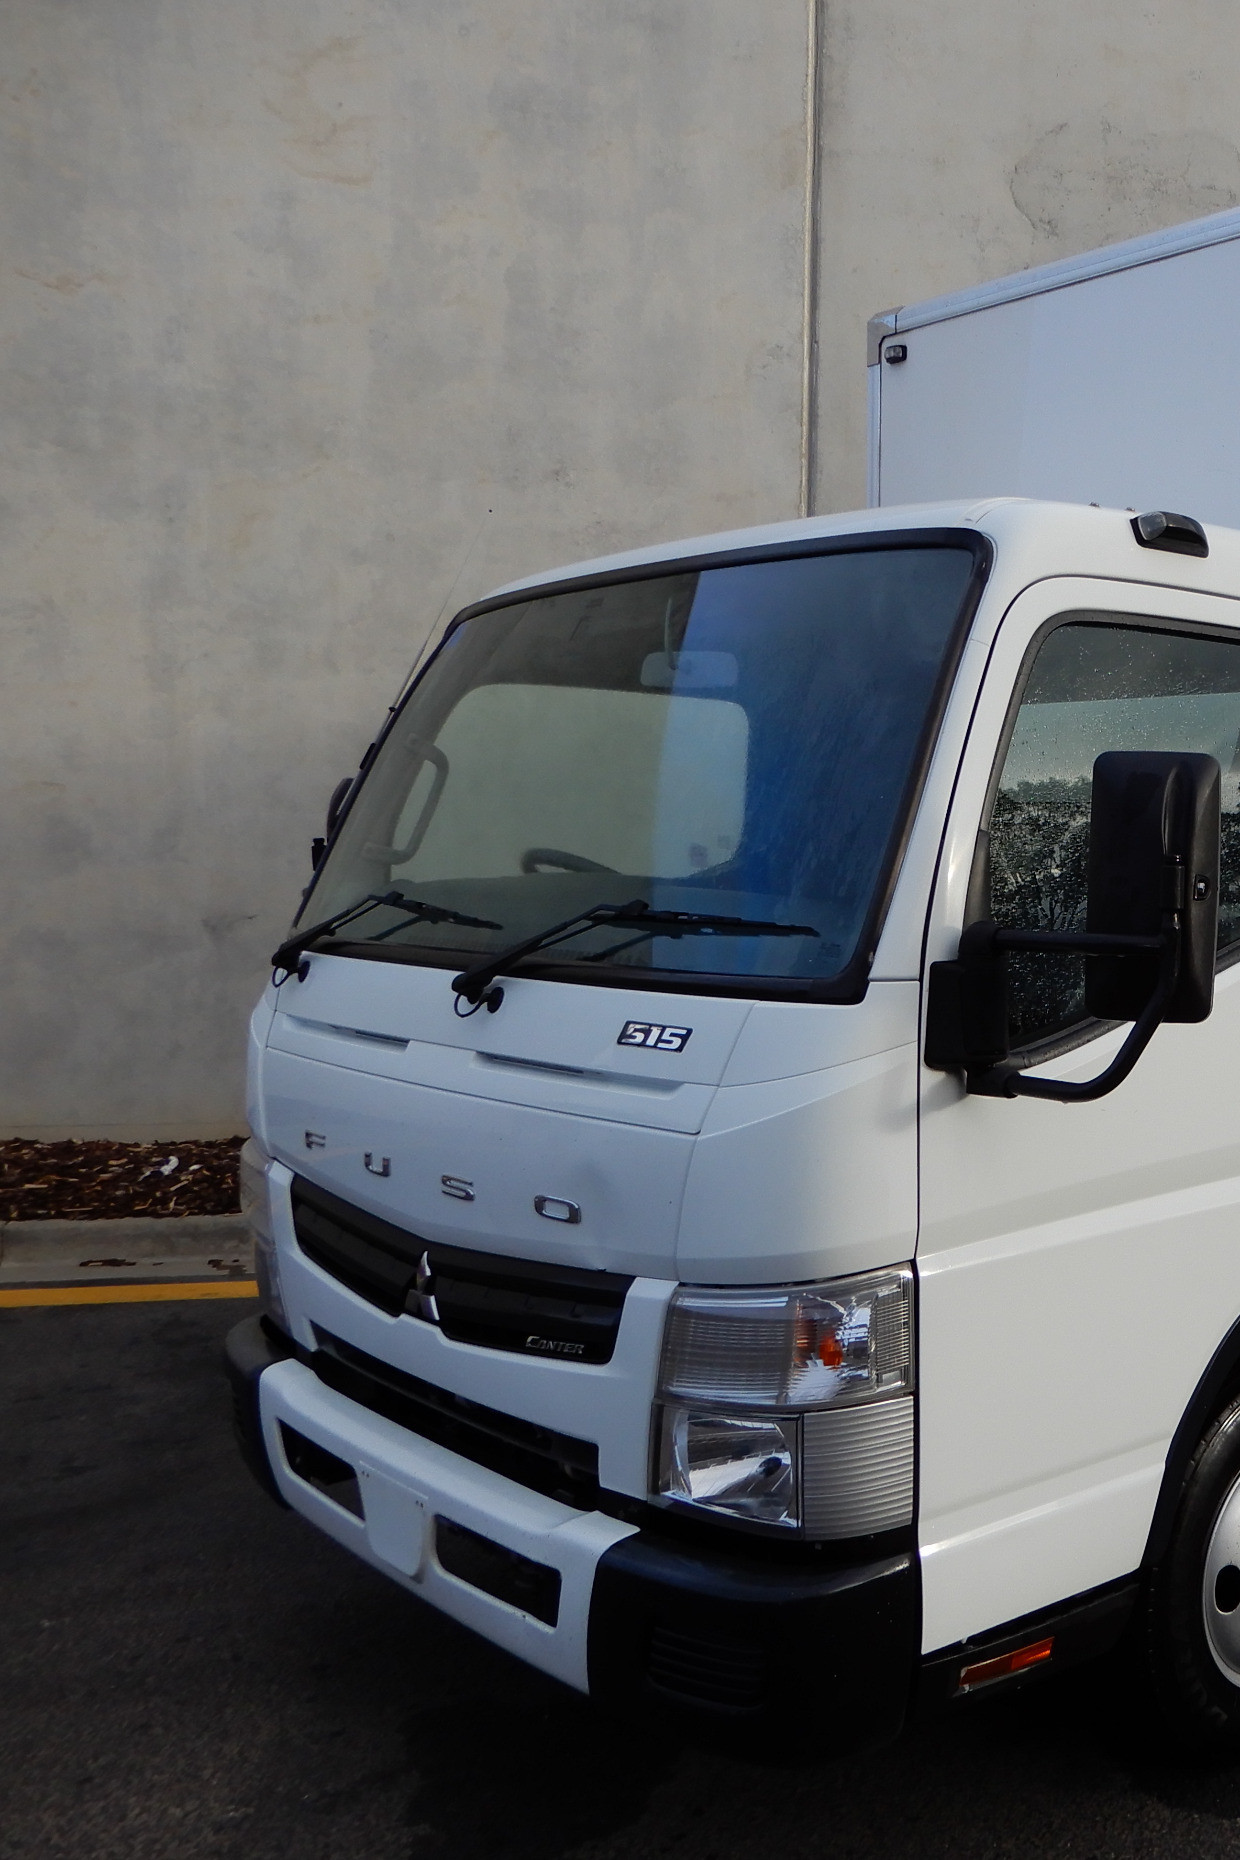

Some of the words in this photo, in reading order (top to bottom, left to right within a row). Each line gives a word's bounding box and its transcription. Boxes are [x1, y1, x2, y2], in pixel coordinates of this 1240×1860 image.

[621, 1023, 688, 1050] 515
[305, 1129, 582, 1224] FUSO
[526, 1335, 585, 1354] CANTER
